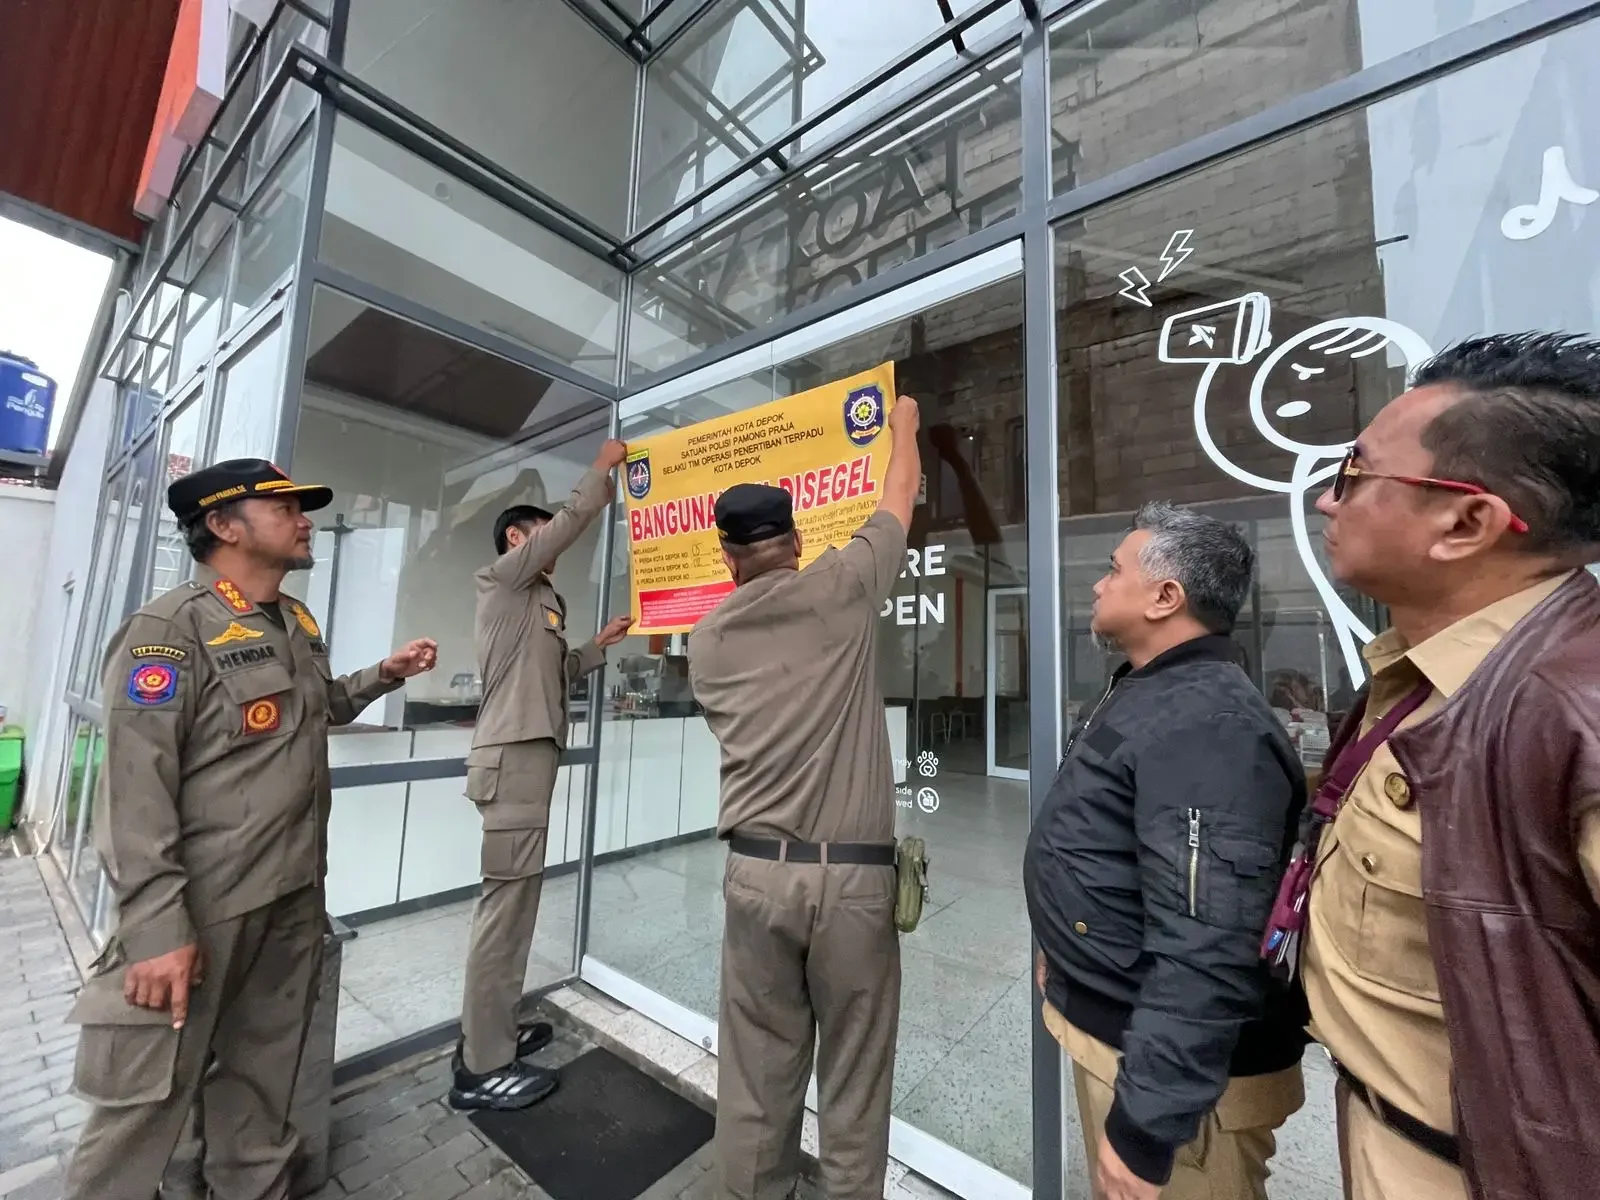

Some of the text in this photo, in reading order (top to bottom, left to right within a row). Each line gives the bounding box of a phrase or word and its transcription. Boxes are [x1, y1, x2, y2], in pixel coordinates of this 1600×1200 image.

[681, 422, 794, 459] SATUAN POLISI PAMONG PRAJA
[688, 412, 784, 446] PEMERINTAH KOTA DEPOK
[662, 426, 824, 476] SELAKU TIM OPERASI PENERTIBAN TERPADU
[714, 455, 761, 474] KOTA DEPOK
[630, 493, 723, 542] BANGUNA
[900, 544, 946, 578] RE
[216, 645, 276, 670] HENDAR
